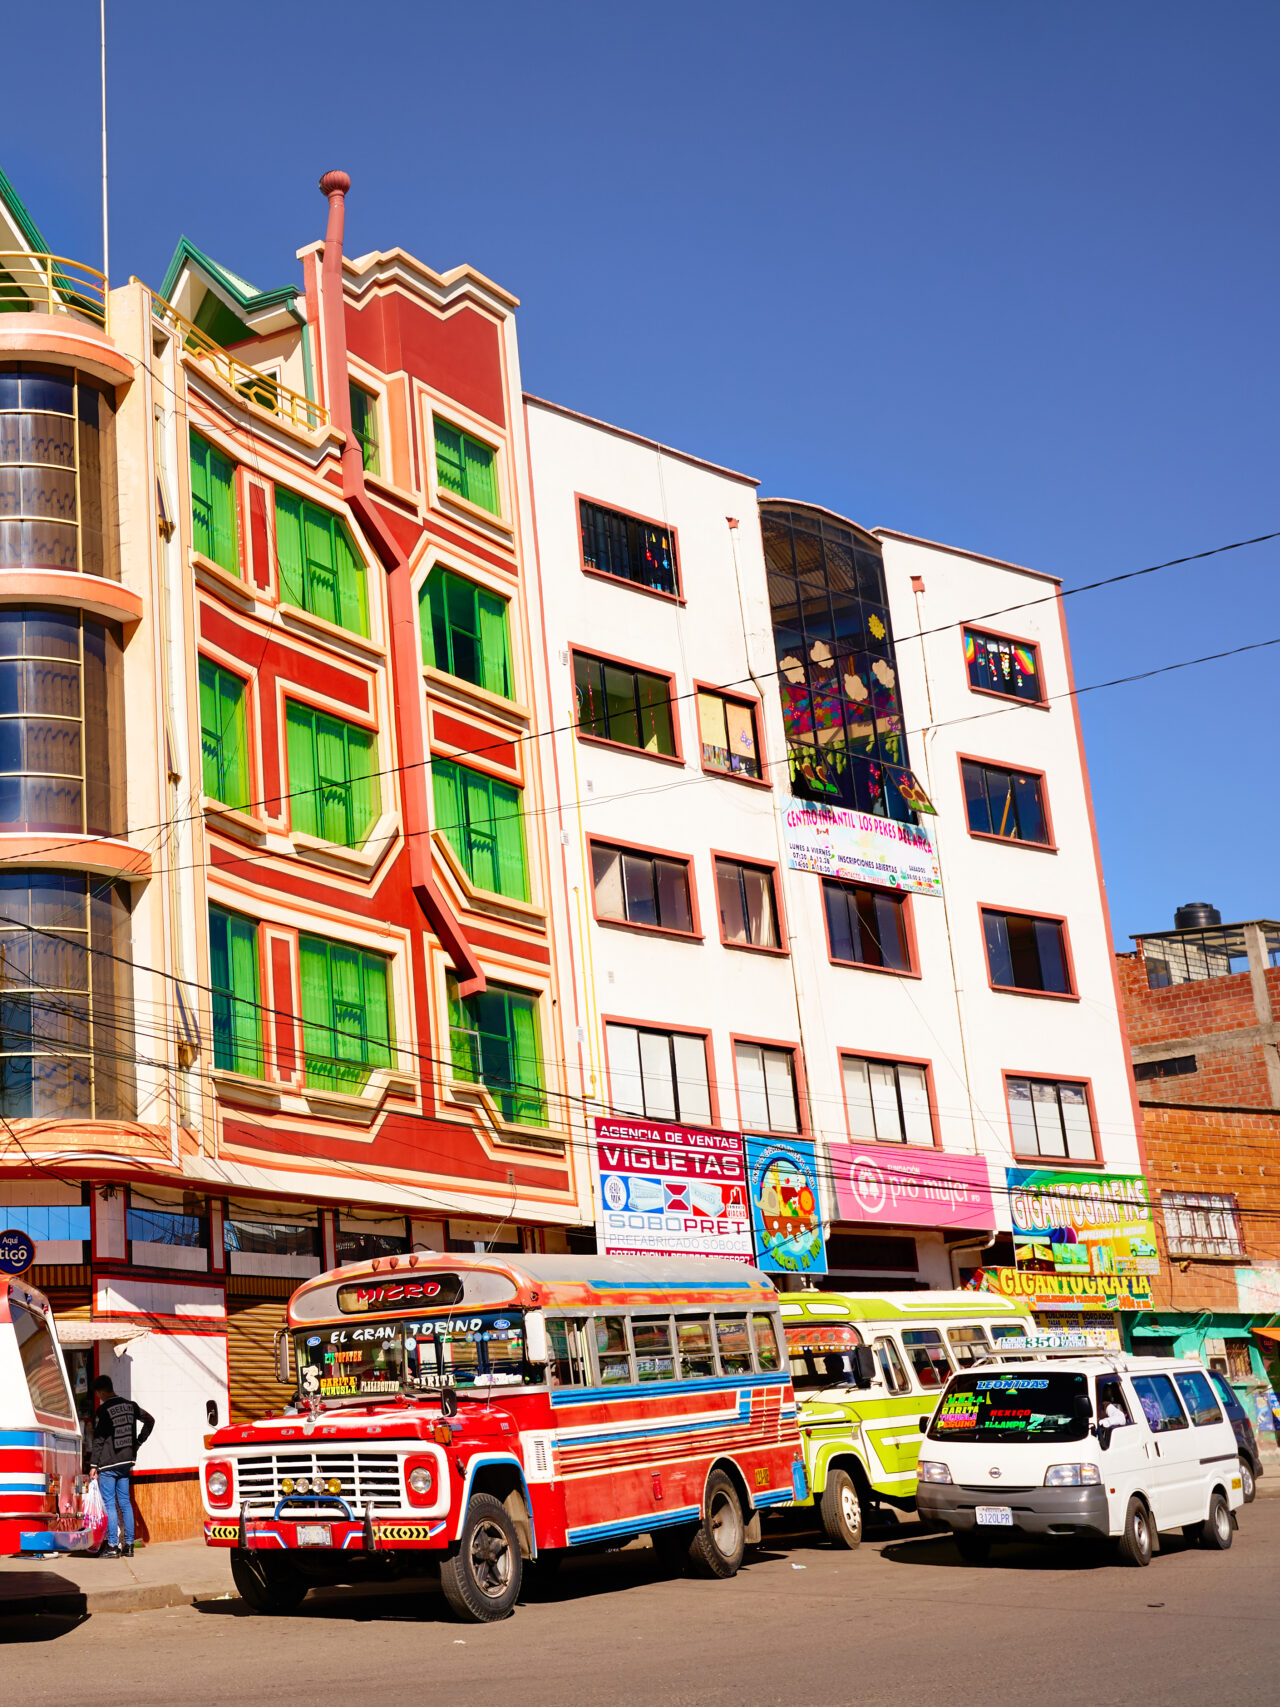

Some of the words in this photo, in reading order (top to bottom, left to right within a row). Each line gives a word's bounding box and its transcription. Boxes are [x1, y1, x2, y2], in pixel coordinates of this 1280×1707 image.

[787, 808, 817, 827] CENTRO
[819, 809, 856, 829] INFANTIL
[873, 817, 897, 839] PEKES
[898, 826, 912, 846] DEL
[837, 854, 874, 869] INSCRIPCIONES
[875, 862, 898, 874] ABIERTAS
[600, 1125, 661, 1141] AGENCIA
[665, 1132, 683, 1144] DE
[687, 1134, 738, 1149] VENTAS
[604, 1145, 740, 1176] VIGUETAS
[888, 1176, 919, 1208] pro
[923, 1176, 969, 1212] mujer
[1012, 1179, 1149, 1230] GIGANTOGRAFIAS
[609, 1214, 745, 1235] SOBOPRET
[609, 1233, 700, 1249] PREFABRICADO
[702, 1240, 749, 1251] SOBOCE
[357, 1282, 441, 1305] MICRO
[330, 1331, 348, 1344] EL
[352, 1326, 396, 1341] GRAN
[410, 1318, 483, 1336] TORINO
[1026, 1336, 1061, 1348] 350
[302, 1365, 320, 1392] 3
[320, 1376, 358, 1388] GARITA
[976, 1379, 1049, 1390] LEONIDAS
[320, 1385, 357, 1396] TUMUSLA
[940, 1413, 977, 1422] TUMUSLA
[942, 1406, 979, 1415] GARITA
[990, 1409, 1031, 1417] MEXICO
[985, 1421, 1026, 1429] ILLAMPU
